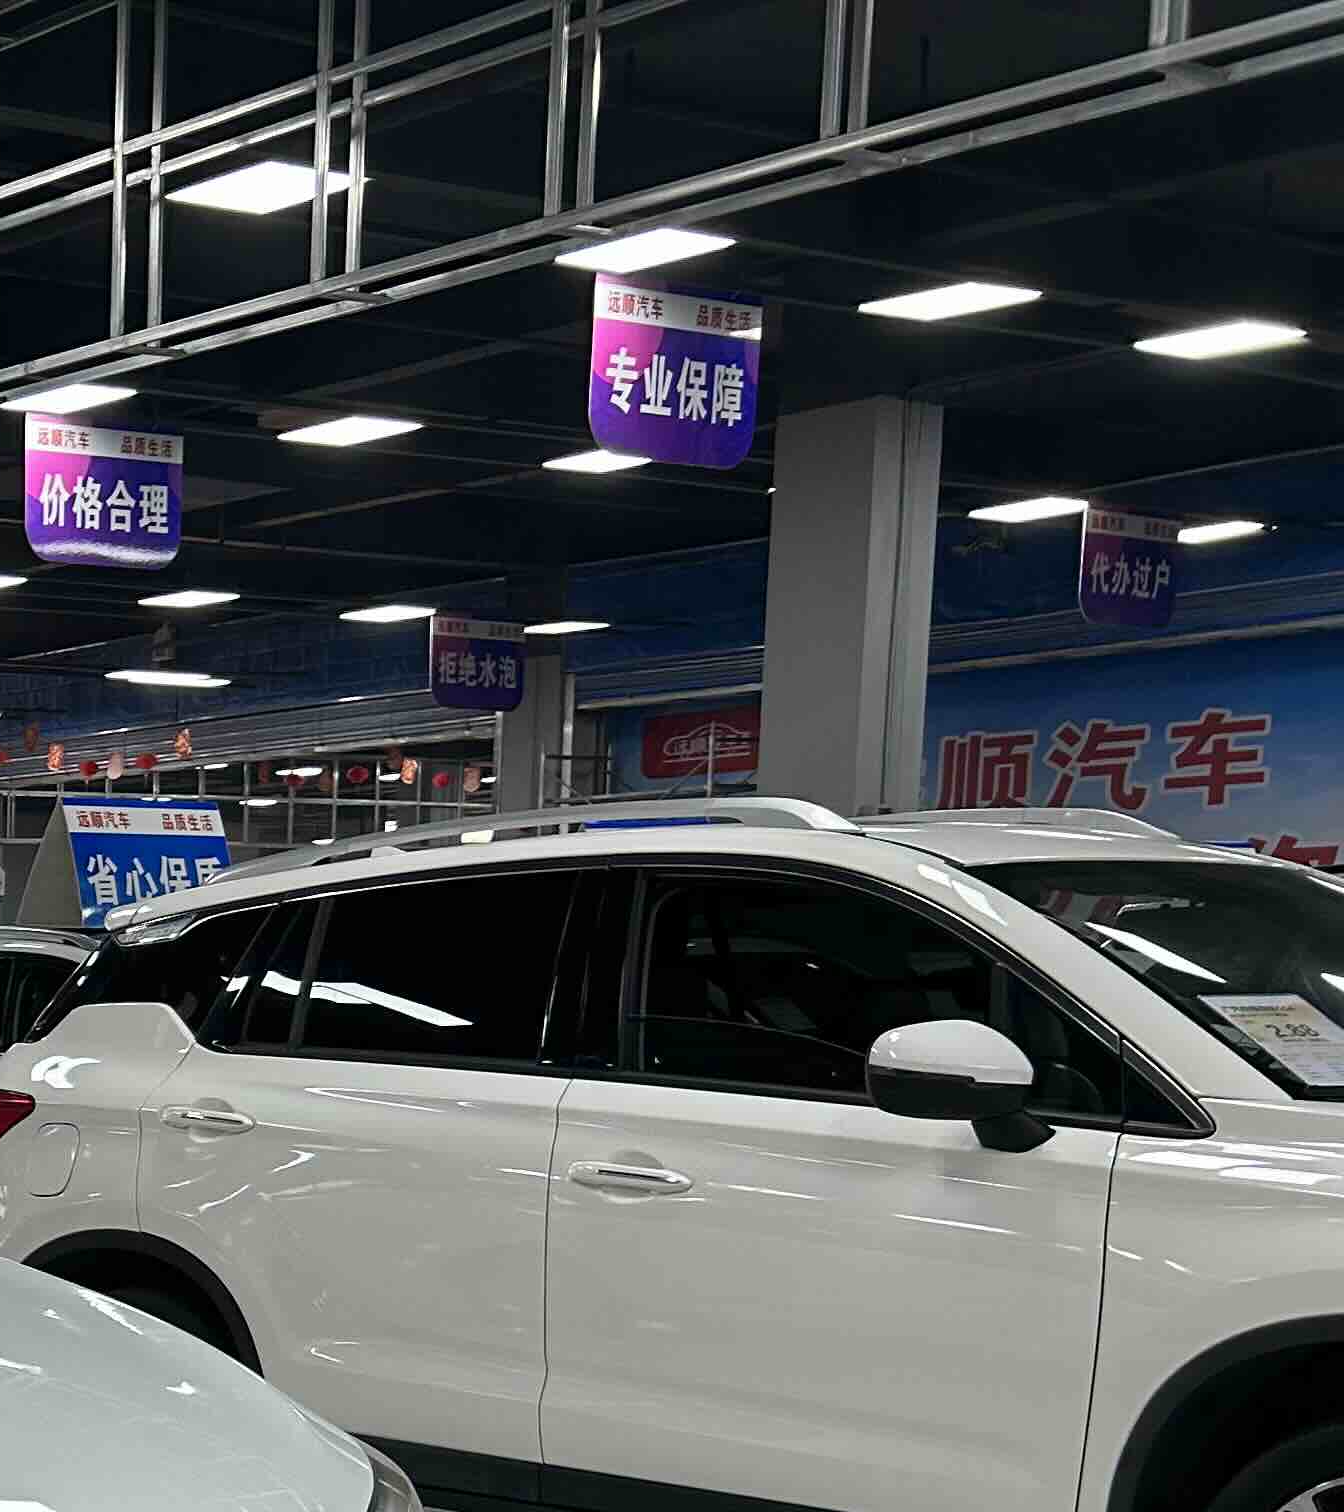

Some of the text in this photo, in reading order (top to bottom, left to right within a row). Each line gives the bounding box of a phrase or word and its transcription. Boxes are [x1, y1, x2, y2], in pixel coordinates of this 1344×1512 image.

[608, 291, 753, 331] 远顺汽车 品质生活
[606, 346, 745, 428] 专业保障
[36, 427, 176, 458] 远顺汽车 品质生活
[39, 472, 170, 535] 价格合理
[1091, 551, 1171, 599] 代办过户
[439, 652, 517, 689] 拒绝水泡
[77, 810, 214, 831] 远顺汽车 品质生活
